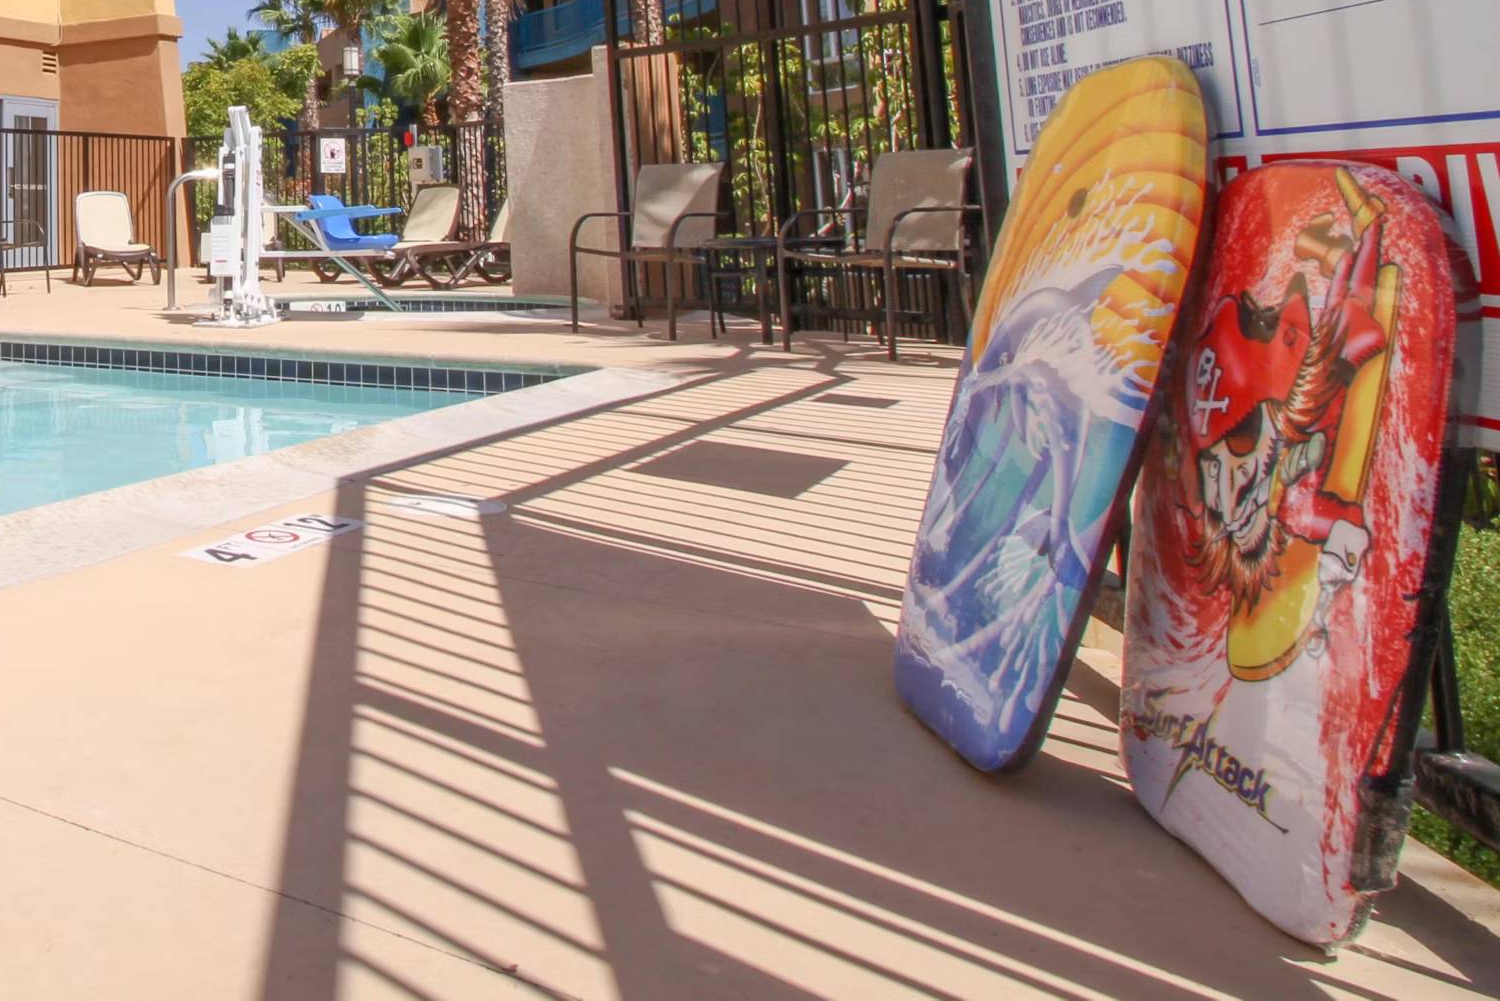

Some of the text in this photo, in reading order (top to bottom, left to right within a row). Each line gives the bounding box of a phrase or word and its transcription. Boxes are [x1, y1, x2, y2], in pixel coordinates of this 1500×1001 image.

[204, 549, 259, 562] 4
[1132, 686, 1272, 814] Surf Attack
